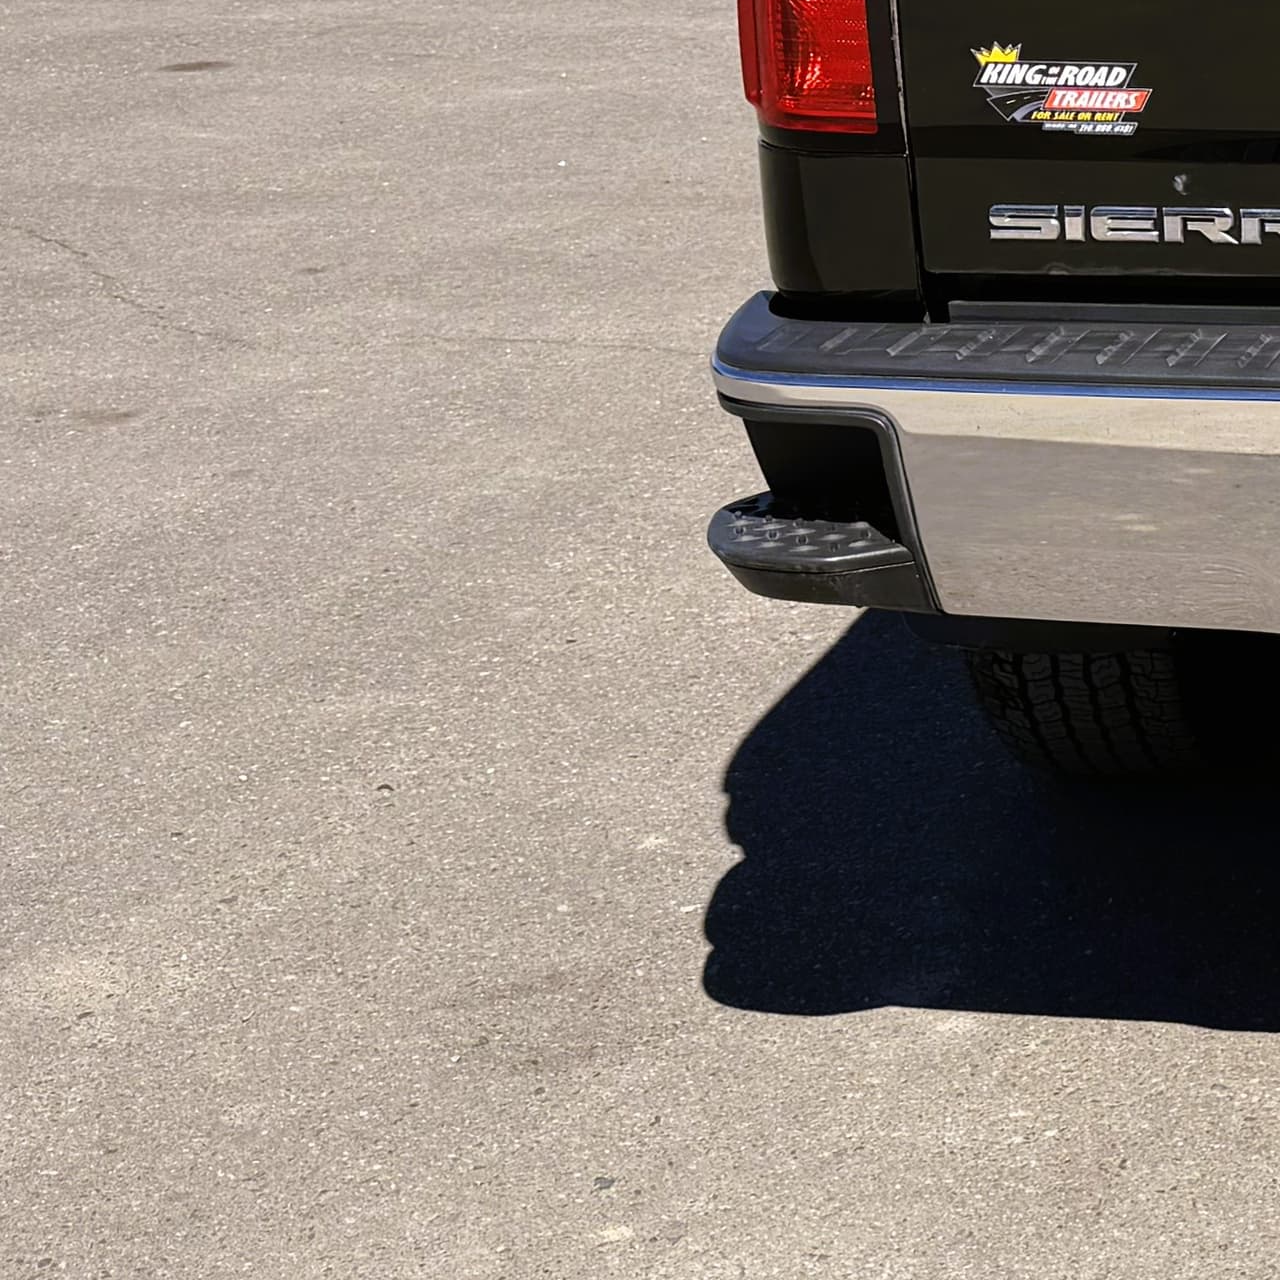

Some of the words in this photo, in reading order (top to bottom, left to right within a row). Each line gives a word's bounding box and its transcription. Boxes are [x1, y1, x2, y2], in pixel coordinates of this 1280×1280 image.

[980, 63, 1047, 85] KING
[1057, 65, 1127, 88] ROAD
[1052, 89, 1138, 109] TRAILERS
[1031, 111, 1052, 120] FOR
[1053, 111, 1075, 121] SALE
[1094, 111, 1120, 122] RENT
